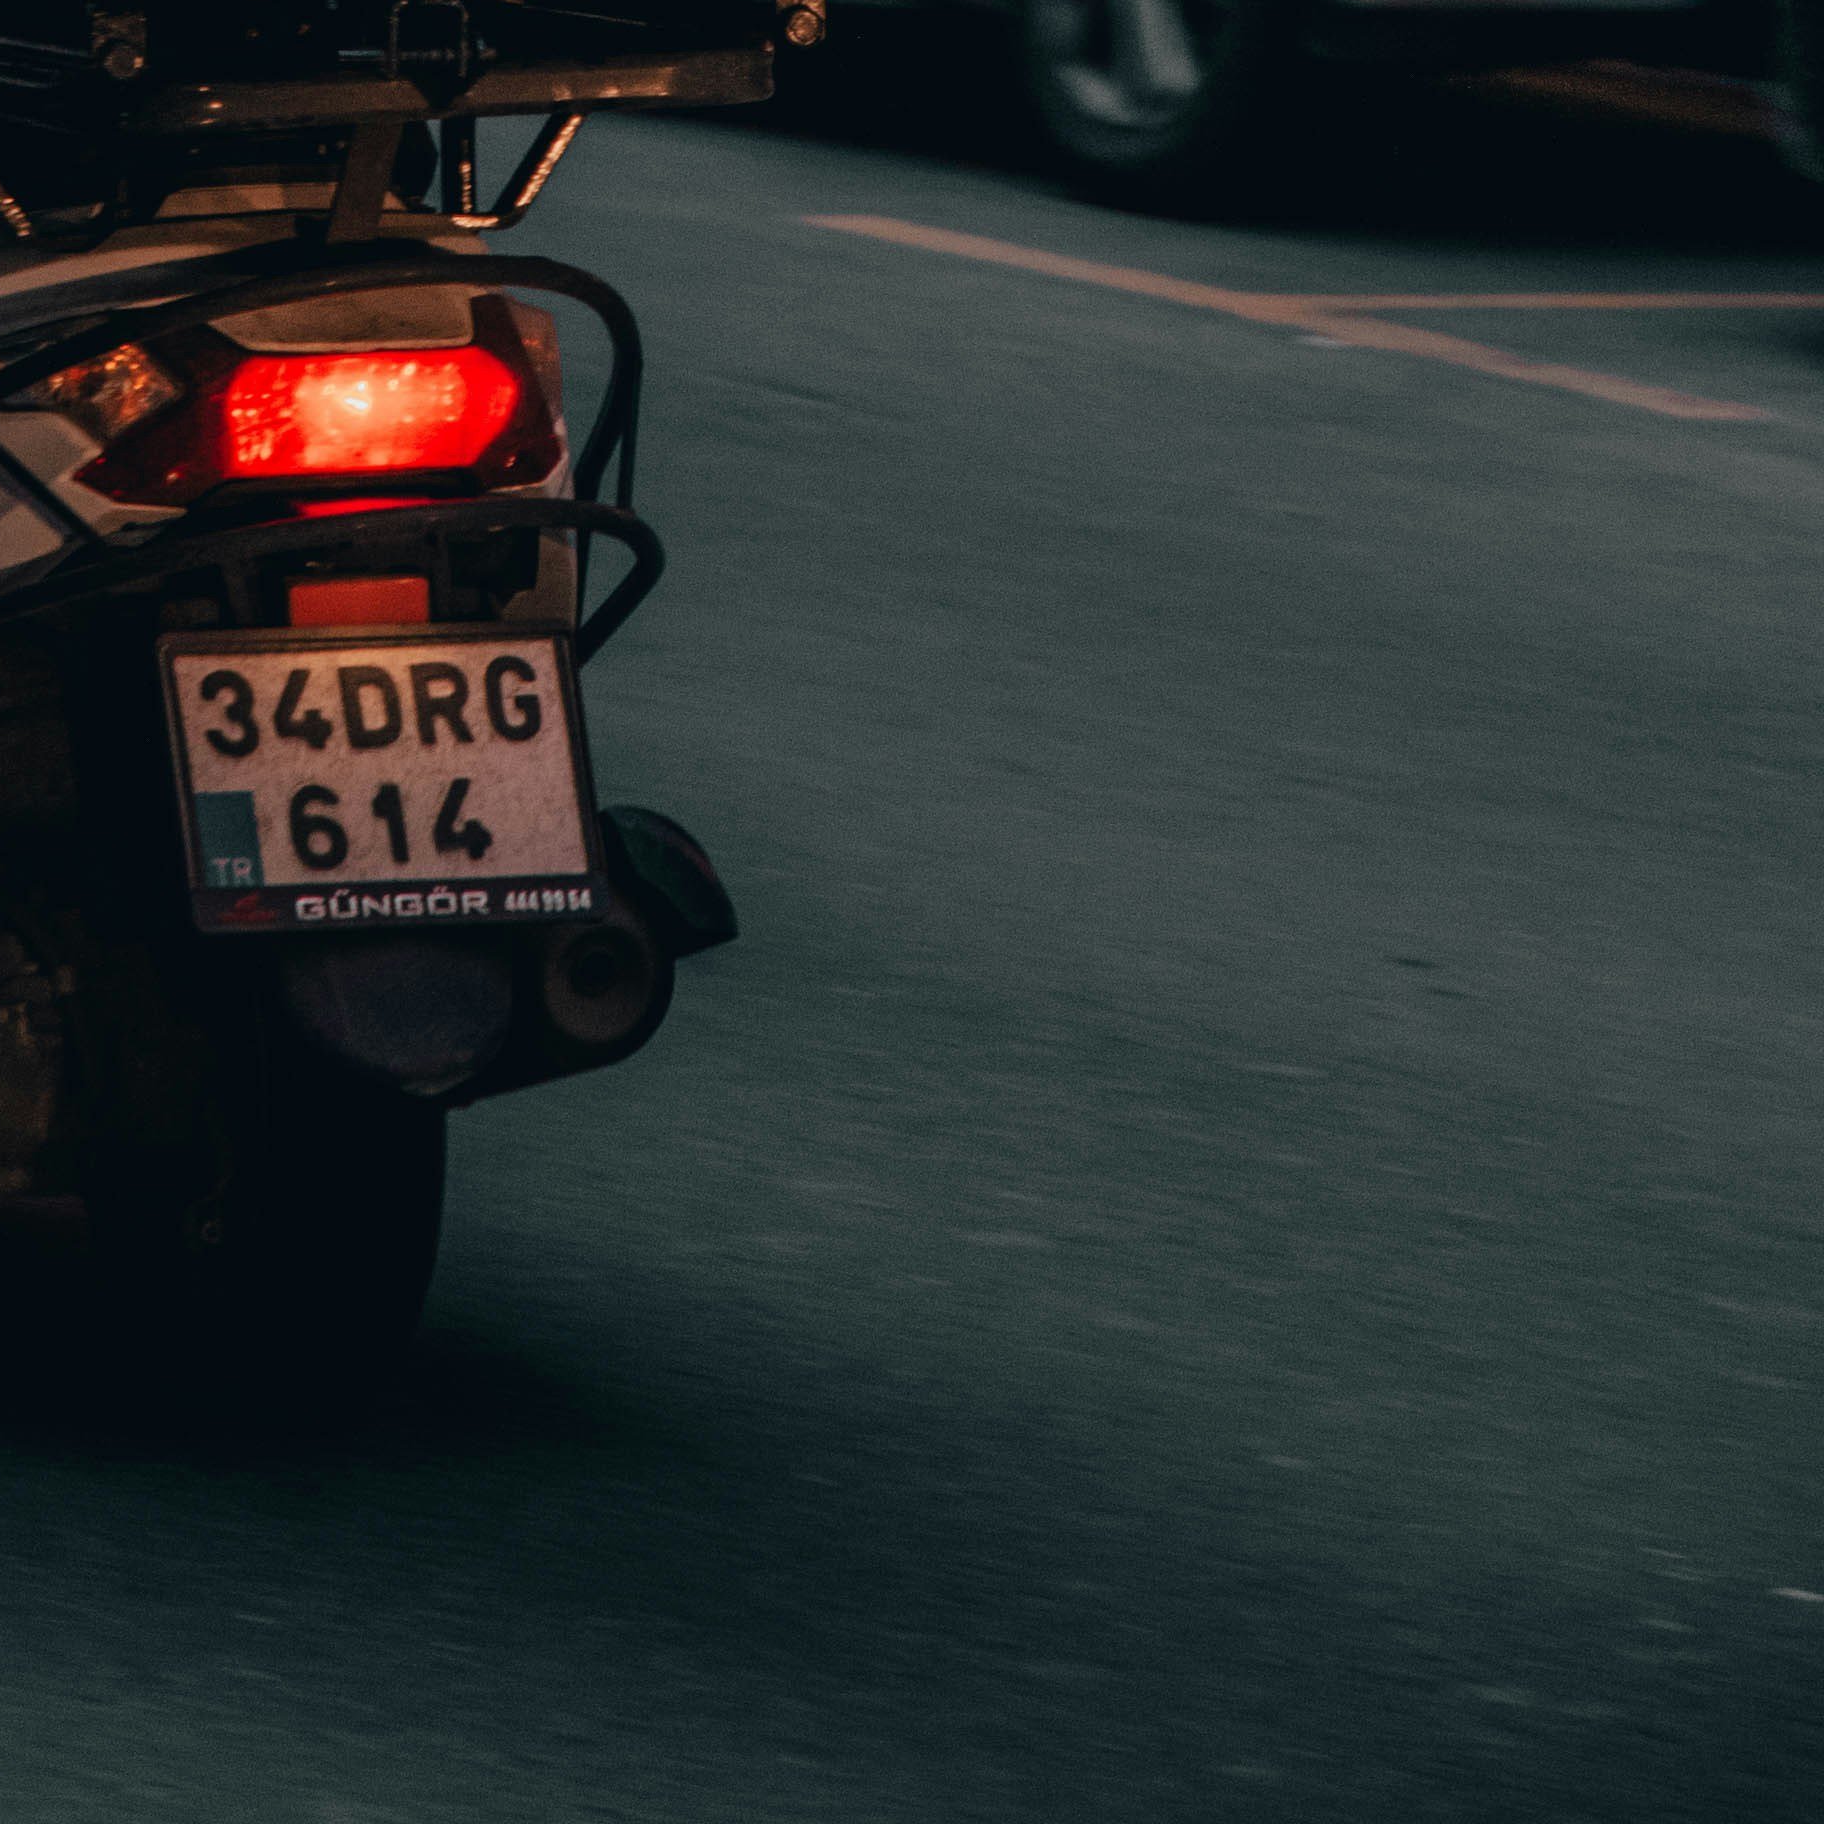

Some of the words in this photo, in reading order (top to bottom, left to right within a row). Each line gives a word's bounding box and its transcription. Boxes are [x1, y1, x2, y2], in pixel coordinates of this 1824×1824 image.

[200, 655, 541, 759] 34DRG
[289, 778, 493, 871] 614
[210, 856, 255, 887] TR
[295, 886, 490, 922] GÜNGÖR
